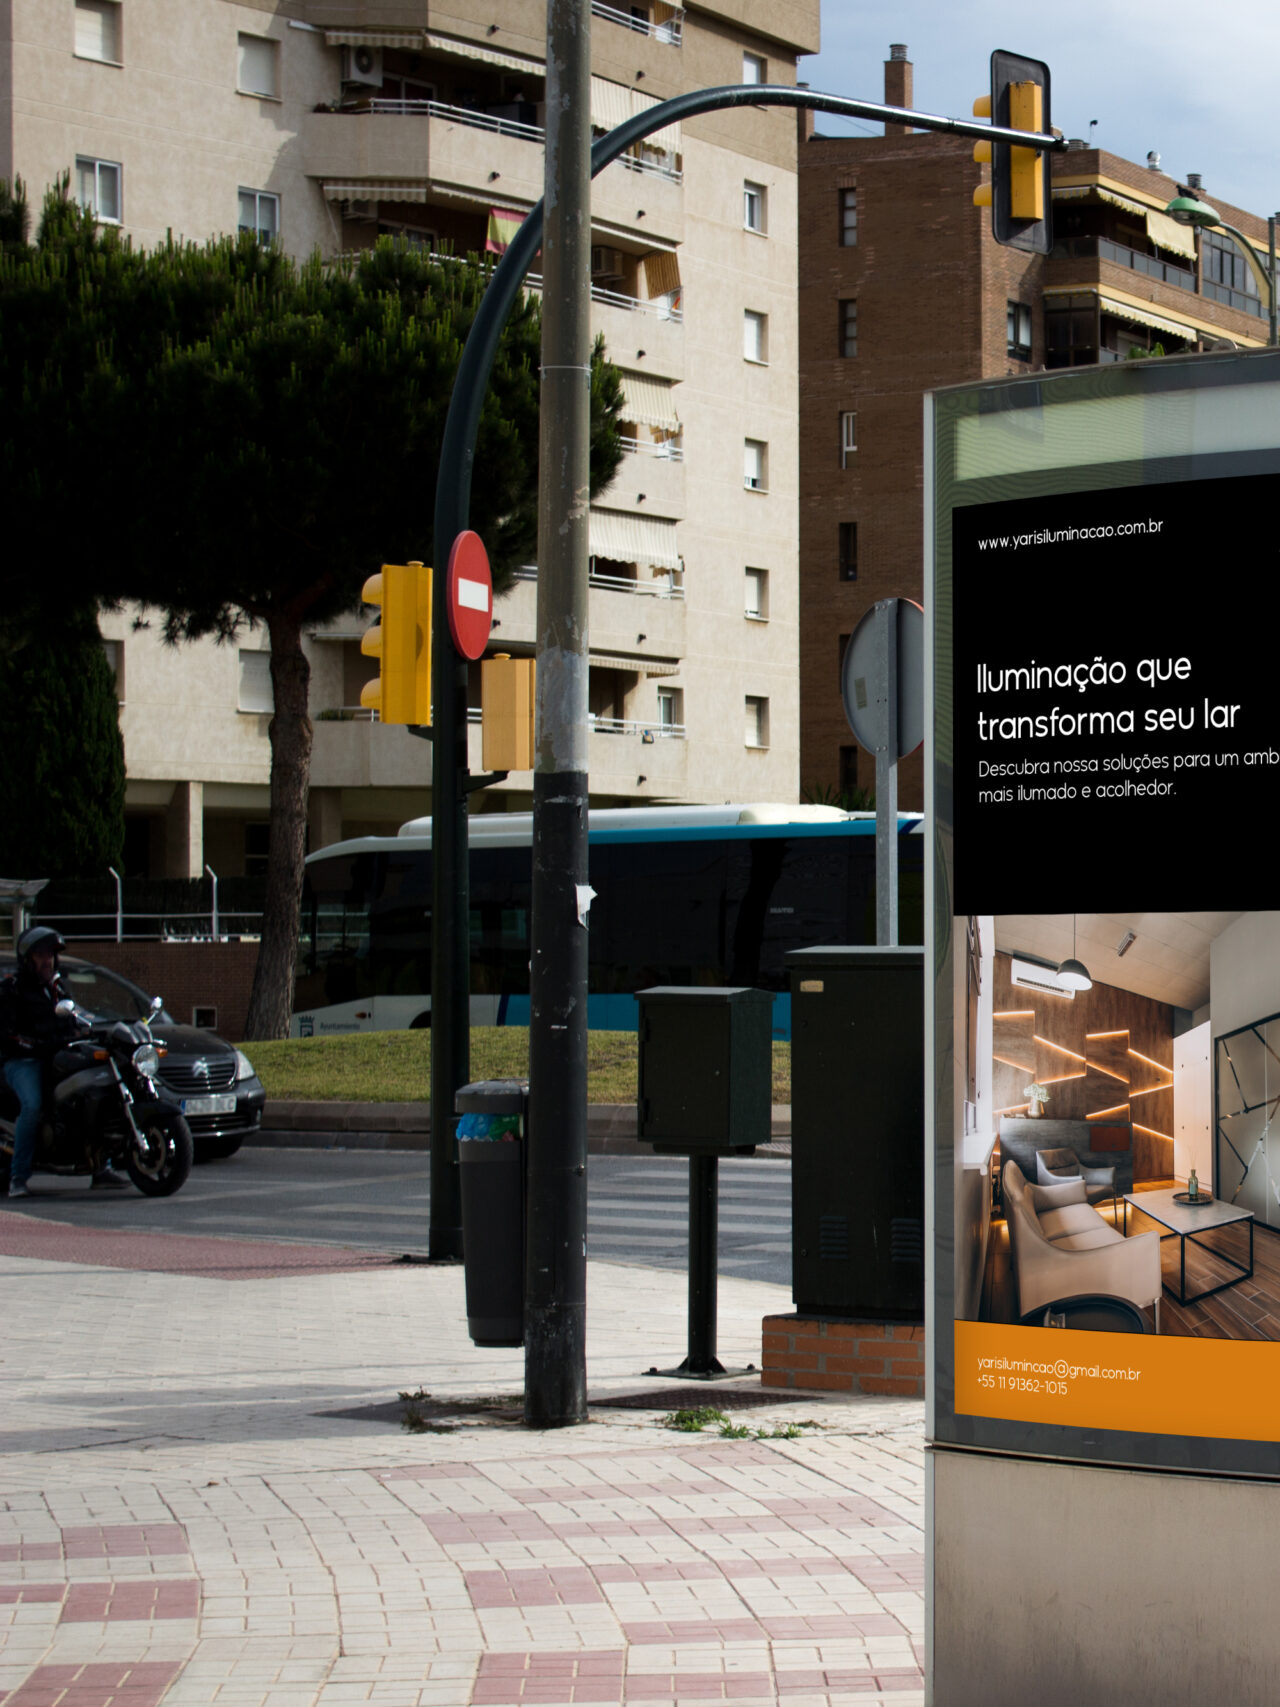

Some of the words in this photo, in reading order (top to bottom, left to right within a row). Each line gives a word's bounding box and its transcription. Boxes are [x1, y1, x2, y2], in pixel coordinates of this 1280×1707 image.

[979, 519, 1163, 550] www.yarisiluminacao.com.br
[978, 656, 1126, 693] Iluminação
[1137, 657, 1191, 687] que
[978, 707, 1134, 740] transforma
[1145, 707, 1194, 731] seu
[1205, 698, 1240, 728] lar
[979, 759, 1049, 777] Descubra
[1054, 760, 1098, 773] nossa
[1103, 754, 1169, 773] soluções
[1174, 755, 1210, 771] para
[1215, 753, 1238, 766] um
[979, 786, 1013, 802] mais
[1018, 783, 1076, 800] ilumado
[1082, 786, 1091, 798] e
[1096, 779, 1176, 797] acolhedor.
[976, 1374, 996, 1388] +55
[998, 1376, 1006, 1389] 11
[1008, 1375, 1068, 1395] 91362-1015
